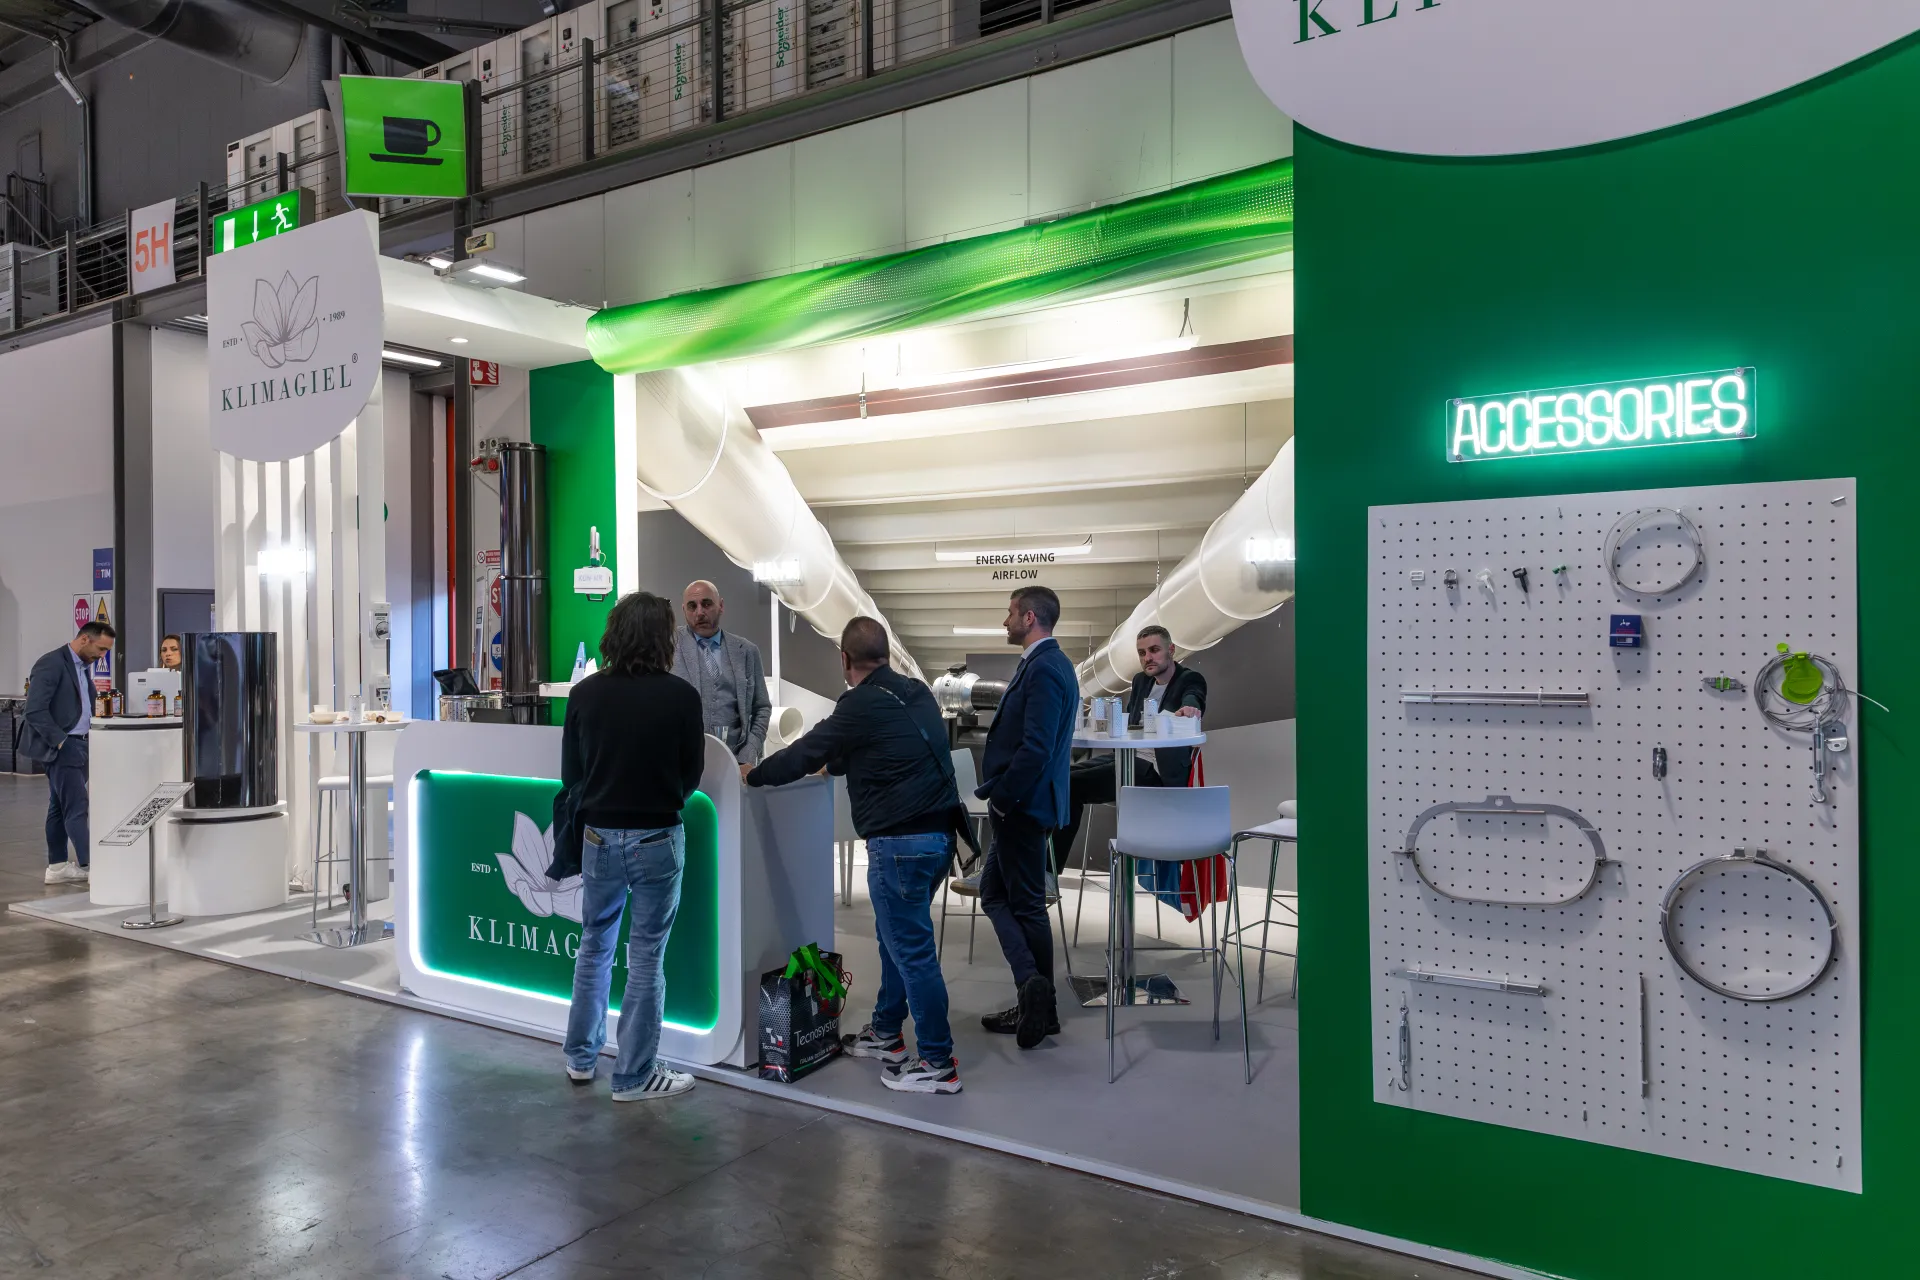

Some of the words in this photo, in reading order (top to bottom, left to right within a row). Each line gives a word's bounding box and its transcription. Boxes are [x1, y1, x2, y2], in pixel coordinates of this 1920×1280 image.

[776, 7, 785, 68] Schneider
[674, 43, 682, 101] Schneider
[135, 222, 169, 273] 5H
[222, 337, 238, 348] ESTD
[329, 310, 346, 322] 1989
[1452, 374, 1748, 456] ACCESSORIES
[976, 554, 1015, 565] ENERGY
[1017, 553, 1055, 563] SAVING
[101, 569, 111, 579] TIM
[992, 569, 1038, 580] AIRFLOW
[75, 607, 90, 620] STOP
[471, 862, 491, 874] ESTD
